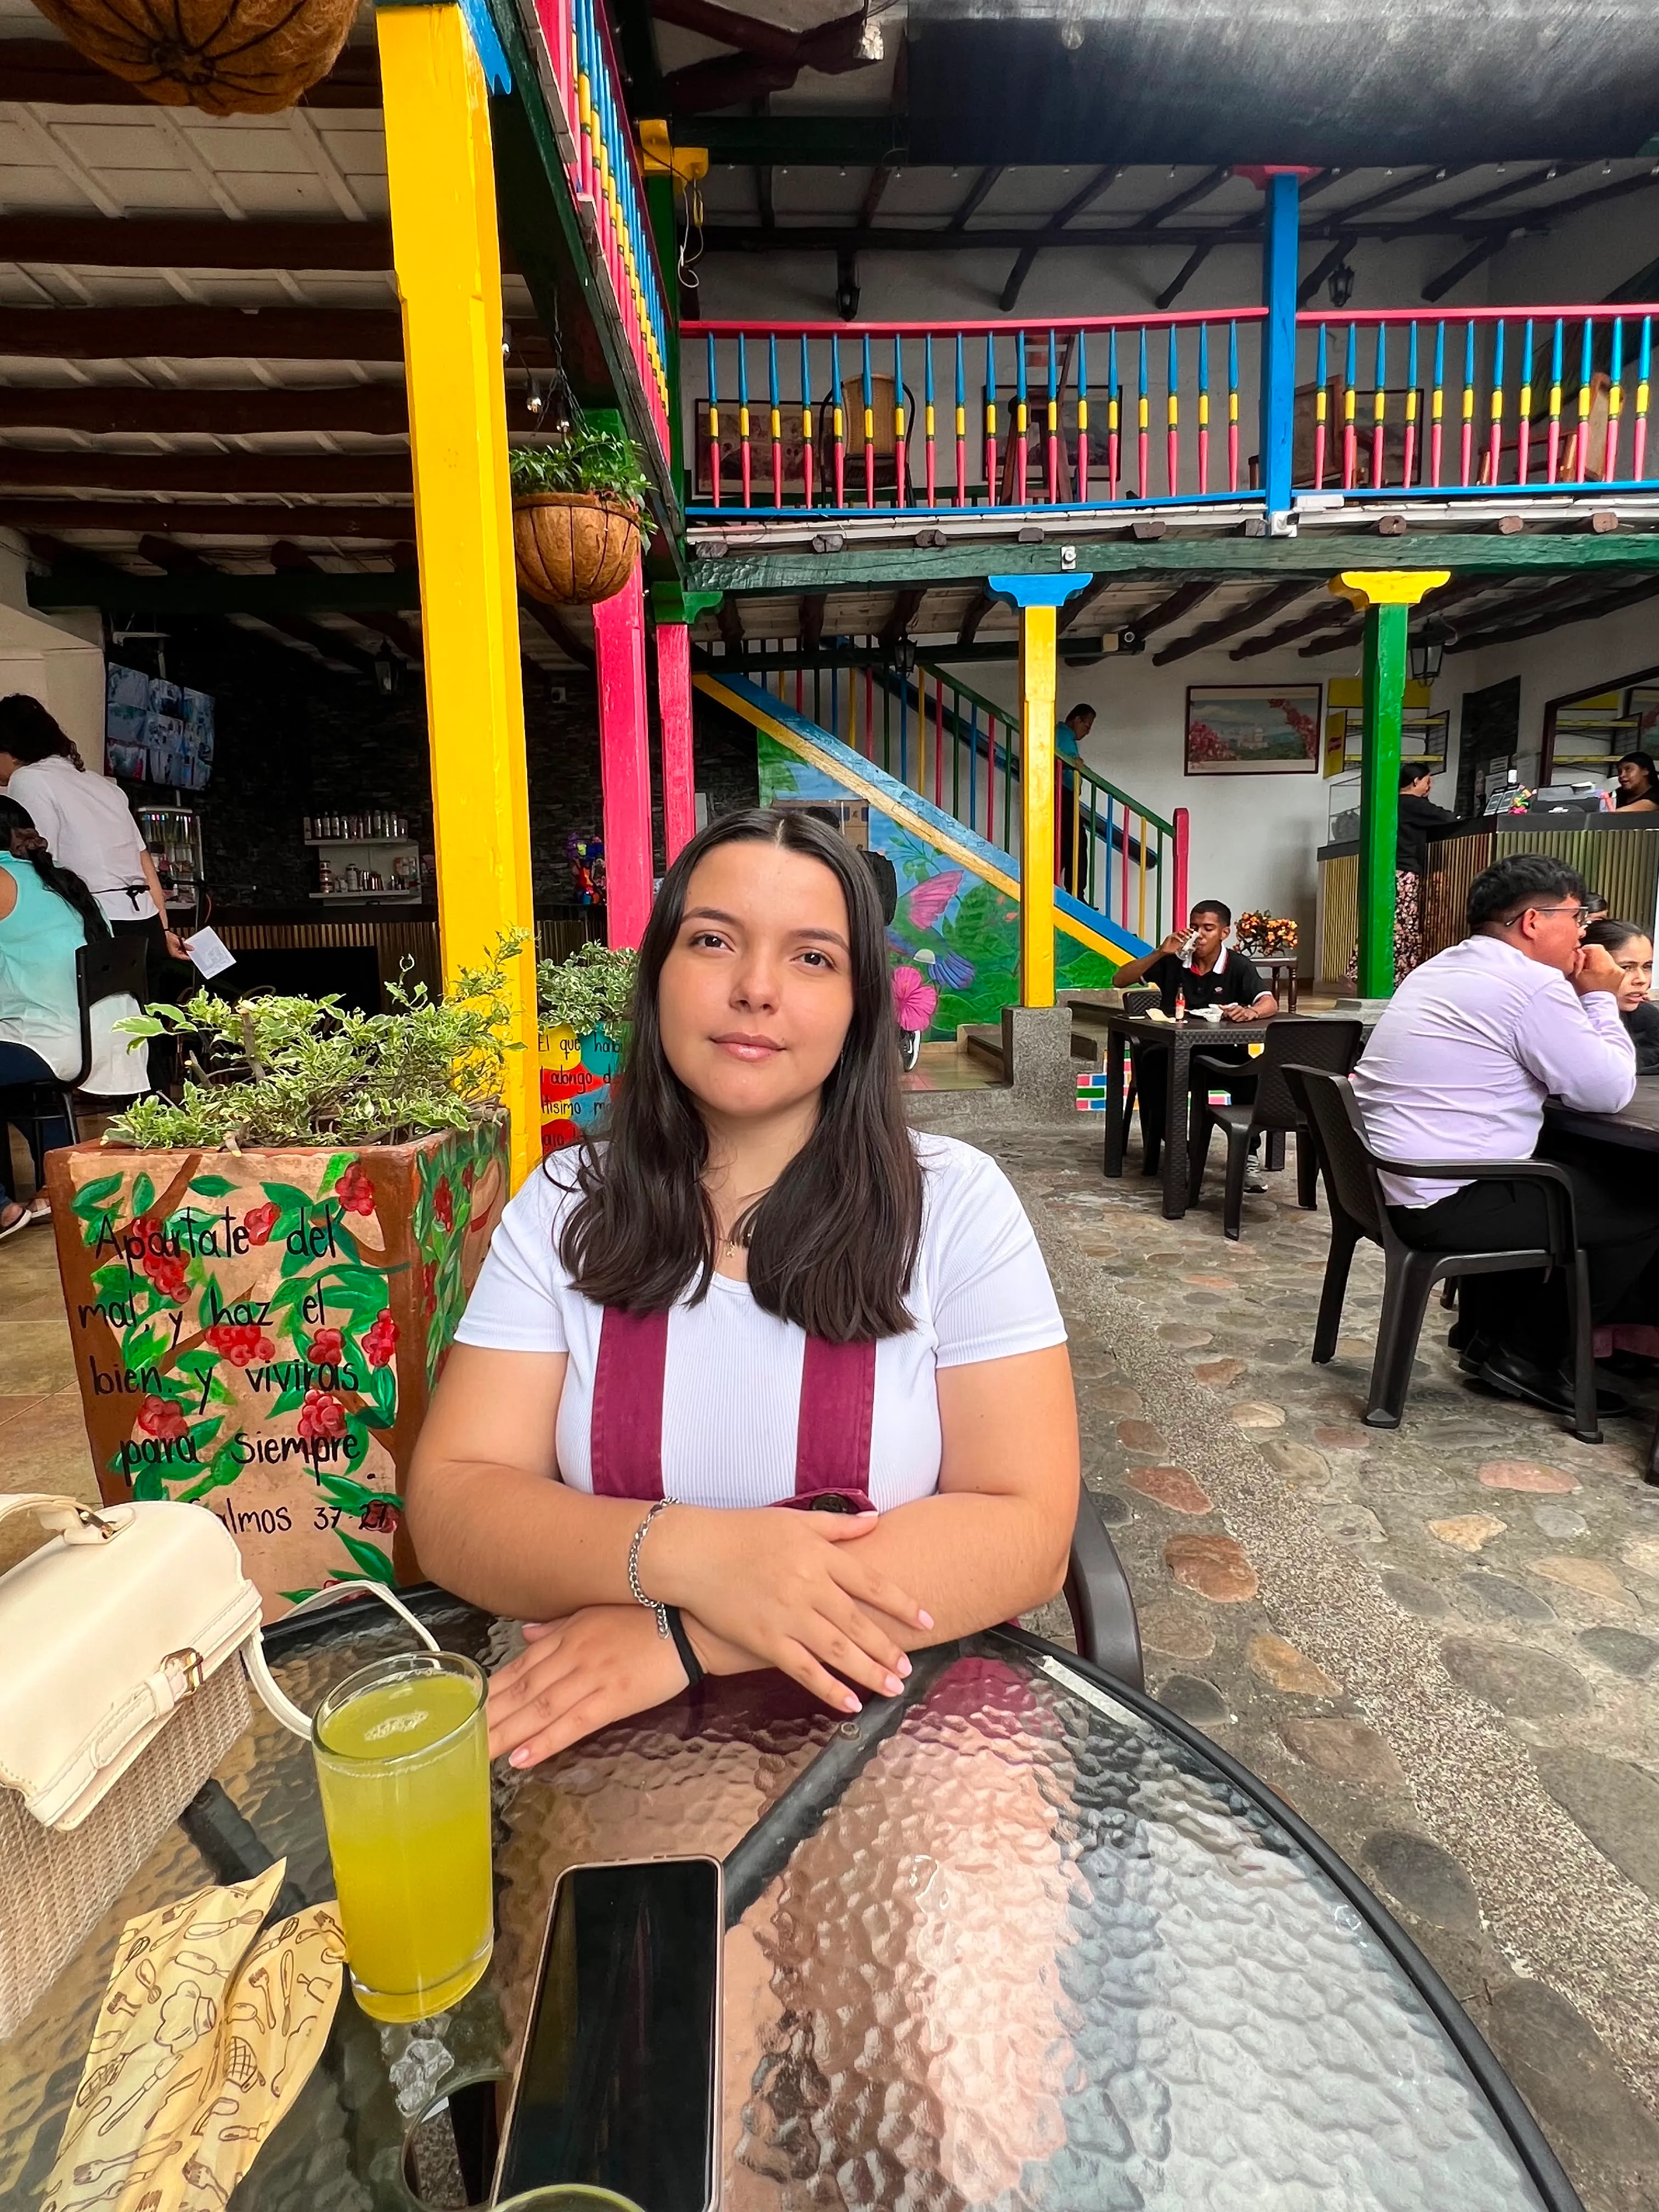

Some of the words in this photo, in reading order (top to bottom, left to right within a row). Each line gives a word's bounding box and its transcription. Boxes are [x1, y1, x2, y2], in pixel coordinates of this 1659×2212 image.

[538, 1034, 550, 1052] El
[559, 1038, 580, 1060] que
[550, 1064, 592, 1094] abrigo
[286, 1204, 336, 1259] del
[168, 1310, 183, 1350] y
[211, 1285, 274, 1327] haz
[302, 1279, 325, 1325] el
[194, 1365, 213, 1415] y
[120, 1434, 203, 1488] para
